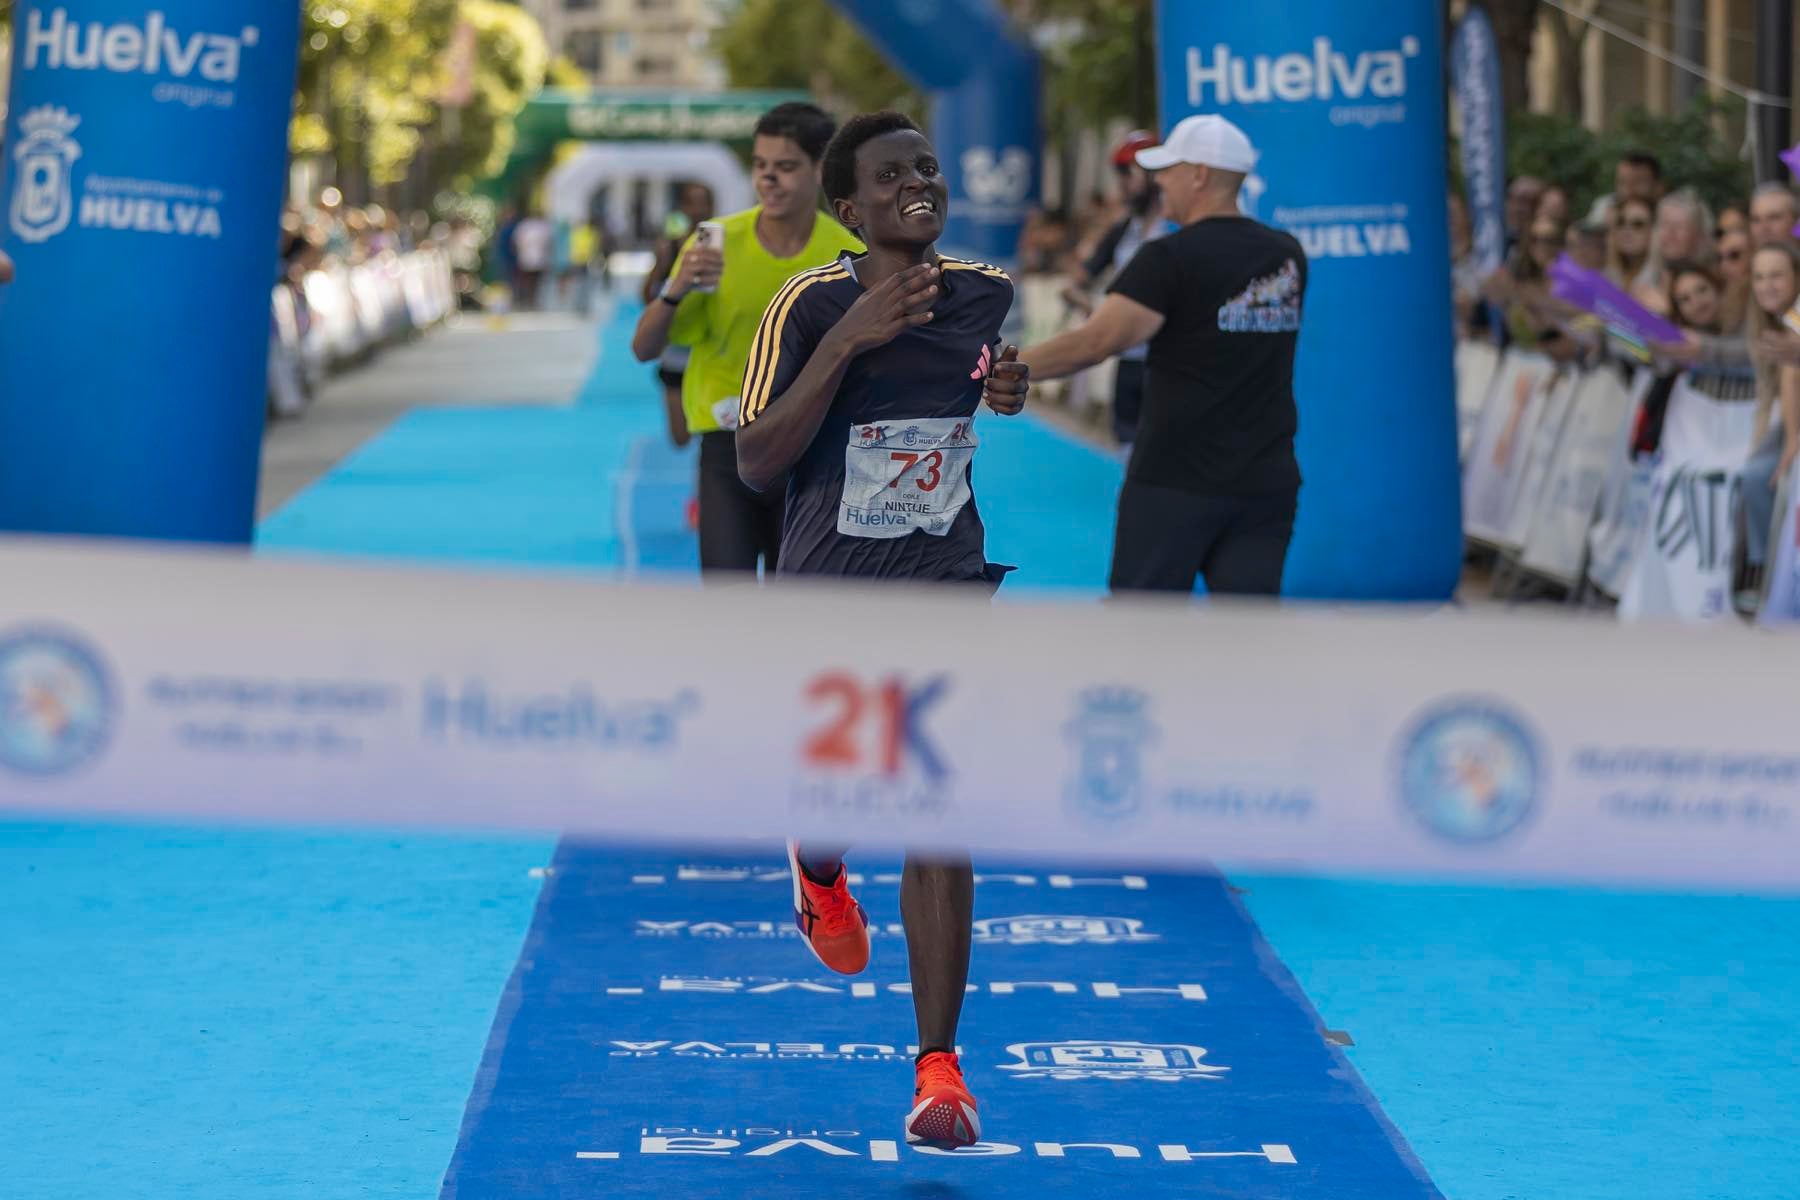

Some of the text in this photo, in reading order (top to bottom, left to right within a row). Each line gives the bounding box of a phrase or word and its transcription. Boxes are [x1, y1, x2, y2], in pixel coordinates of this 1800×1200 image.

[23, 6, 242, 83] Huelva
[1186, 36, 1406, 107] Huelva
[78, 194, 222, 238] HUELVA
[1300, 222, 1411, 258] UELVA
[889, 450, 943, 491] 73
[847, 508, 908, 526] Huelva
[798, 667, 952, 783] 21K
[640, 1127, 861, 1137] original
